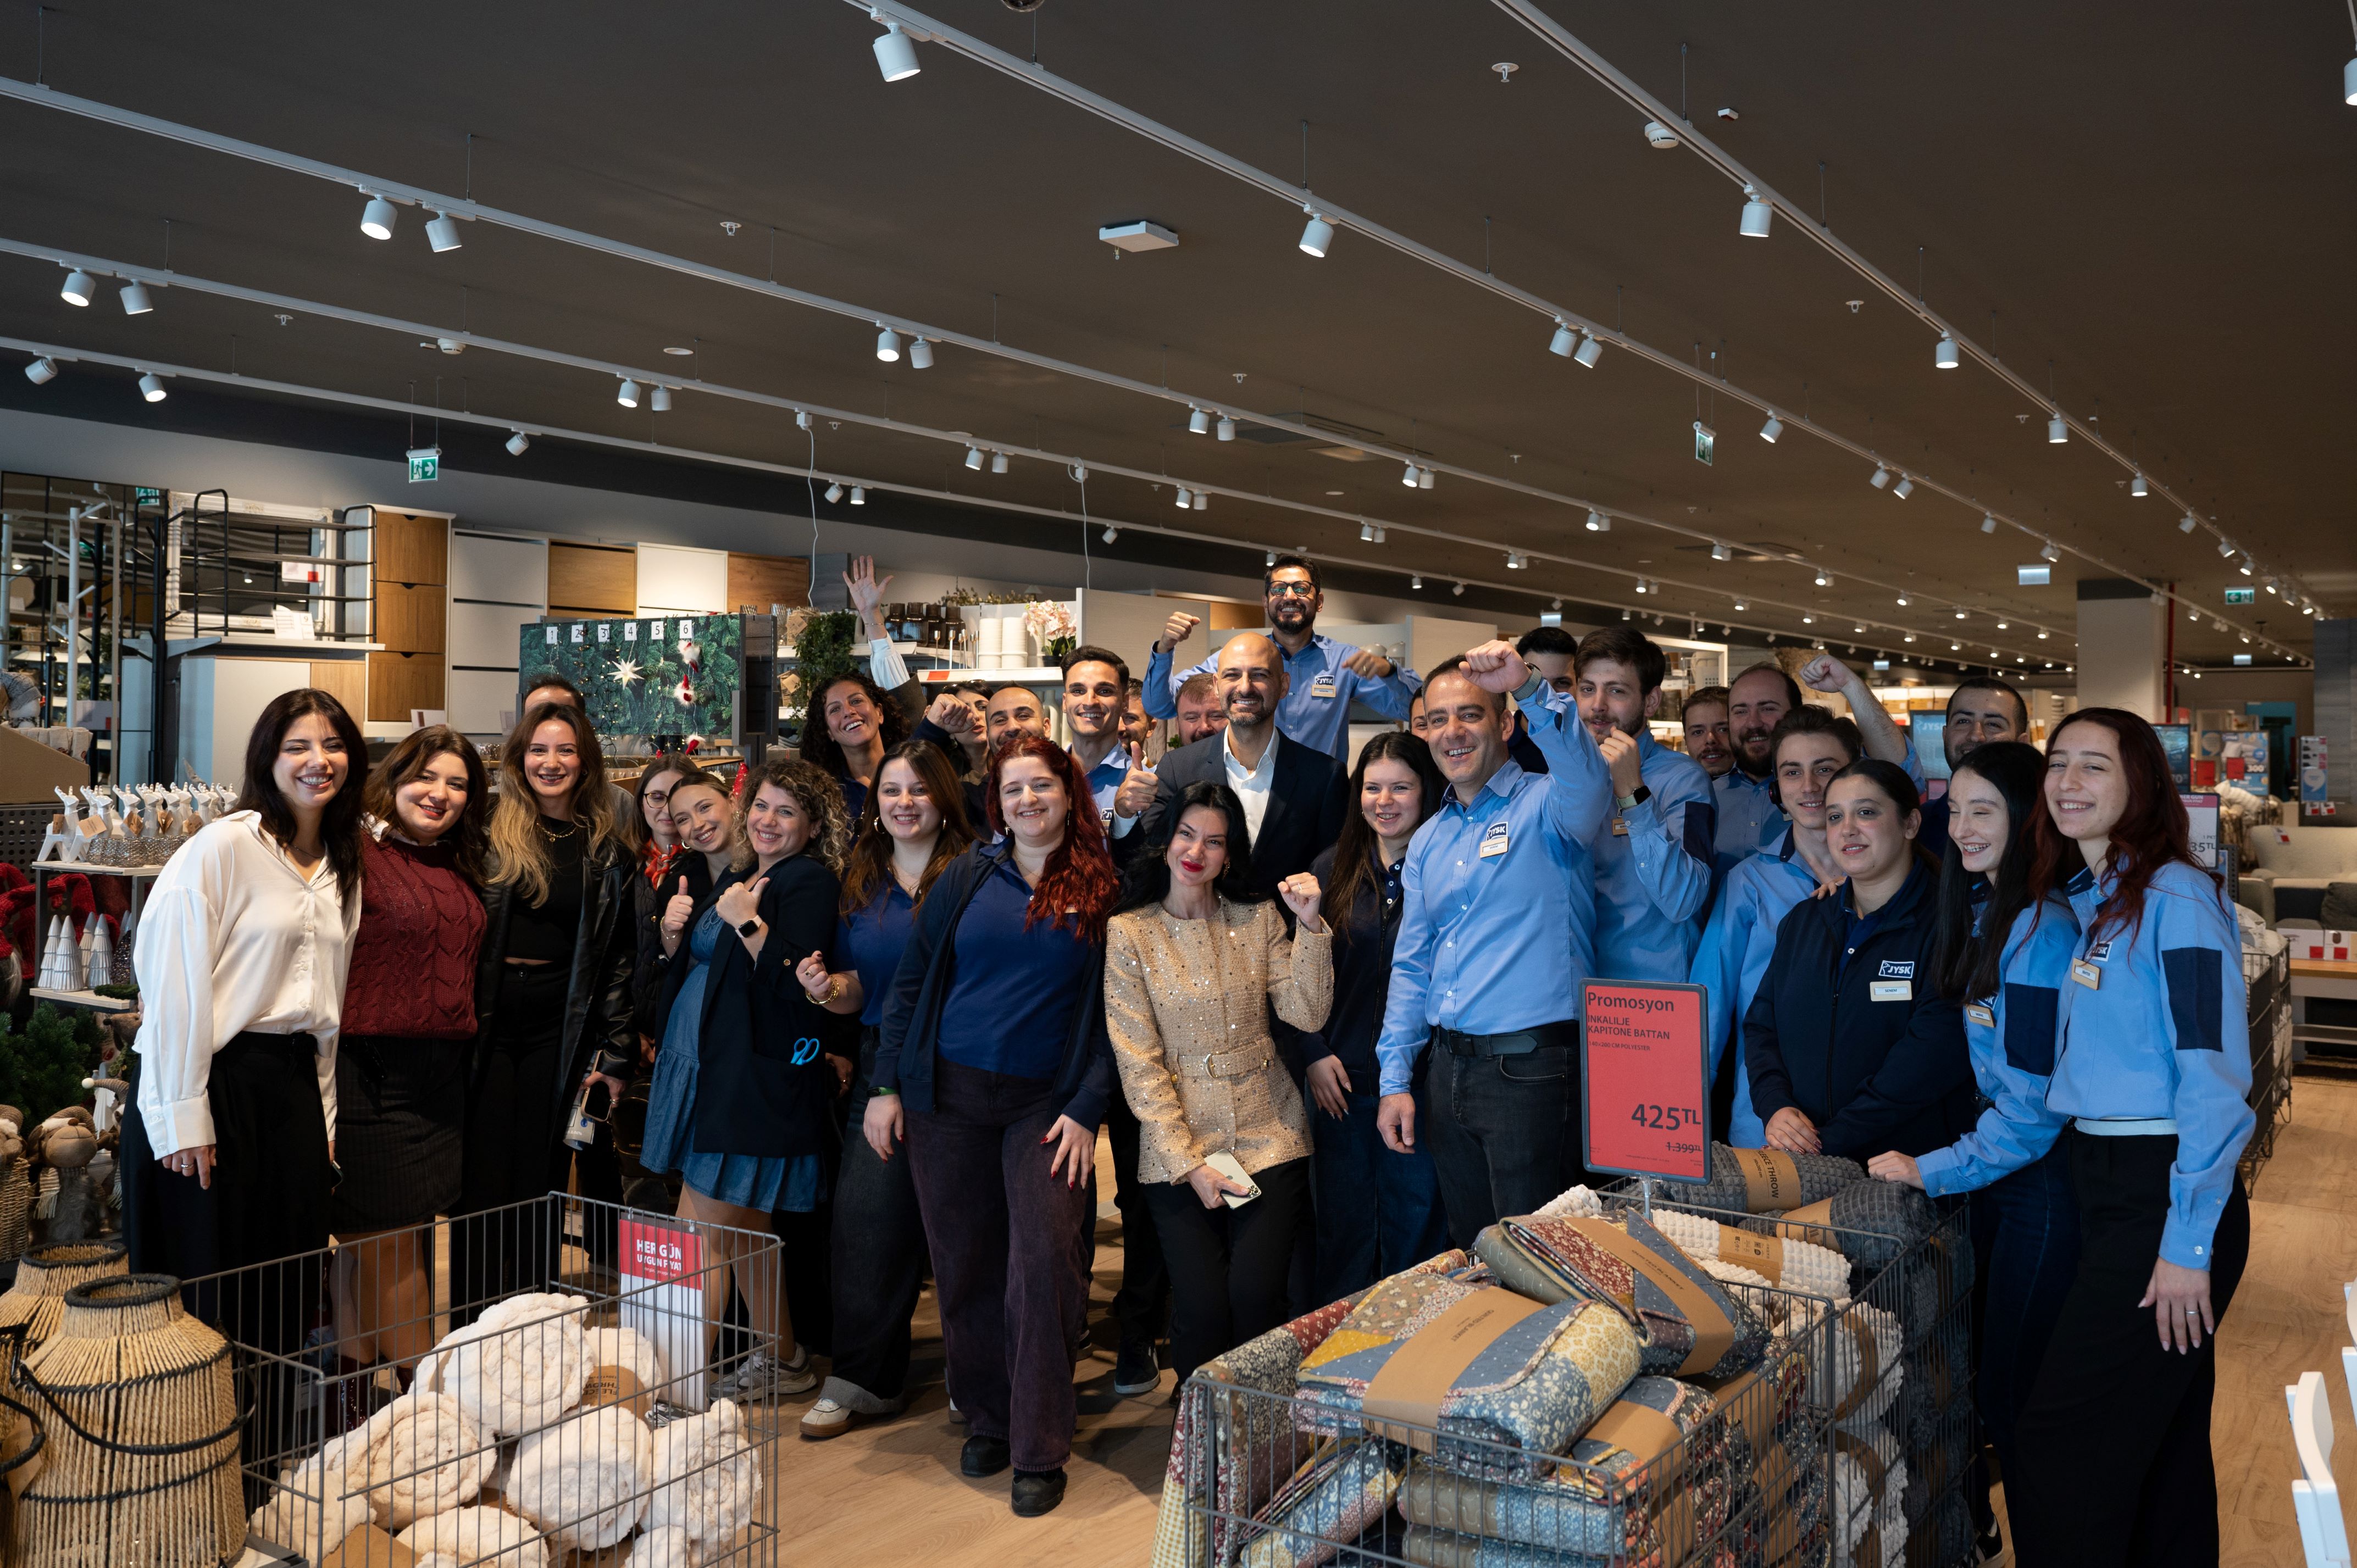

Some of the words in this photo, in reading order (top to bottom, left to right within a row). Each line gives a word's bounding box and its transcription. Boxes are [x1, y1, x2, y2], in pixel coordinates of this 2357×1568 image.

[575, 629, 580, 638] 2
[602, 629, 607, 638] 3
[628, 626, 634, 636] 4
[655, 625, 660, 635] 5
[683, 624, 689, 634] 6
[1490, 826, 1506, 837] JYSK
[1887, 966, 1911, 975] JYSK
[1588, 992, 1674, 1014] Promosyon
[1588, 1015, 1631, 1026] INKALILJE
[1588, 1025, 1632, 1037] KAPITONE
[1634, 1028, 1670, 1039] BATTAN
[1621, 1043, 1650, 1051] POLYESTER
[1767, 1166, 1779, 1199] THROW
[636, 1239, 656, 1255] HER
[659, 1242, 682, 1260] GÜN
[663, 1259, 682, 1271] FYAT
